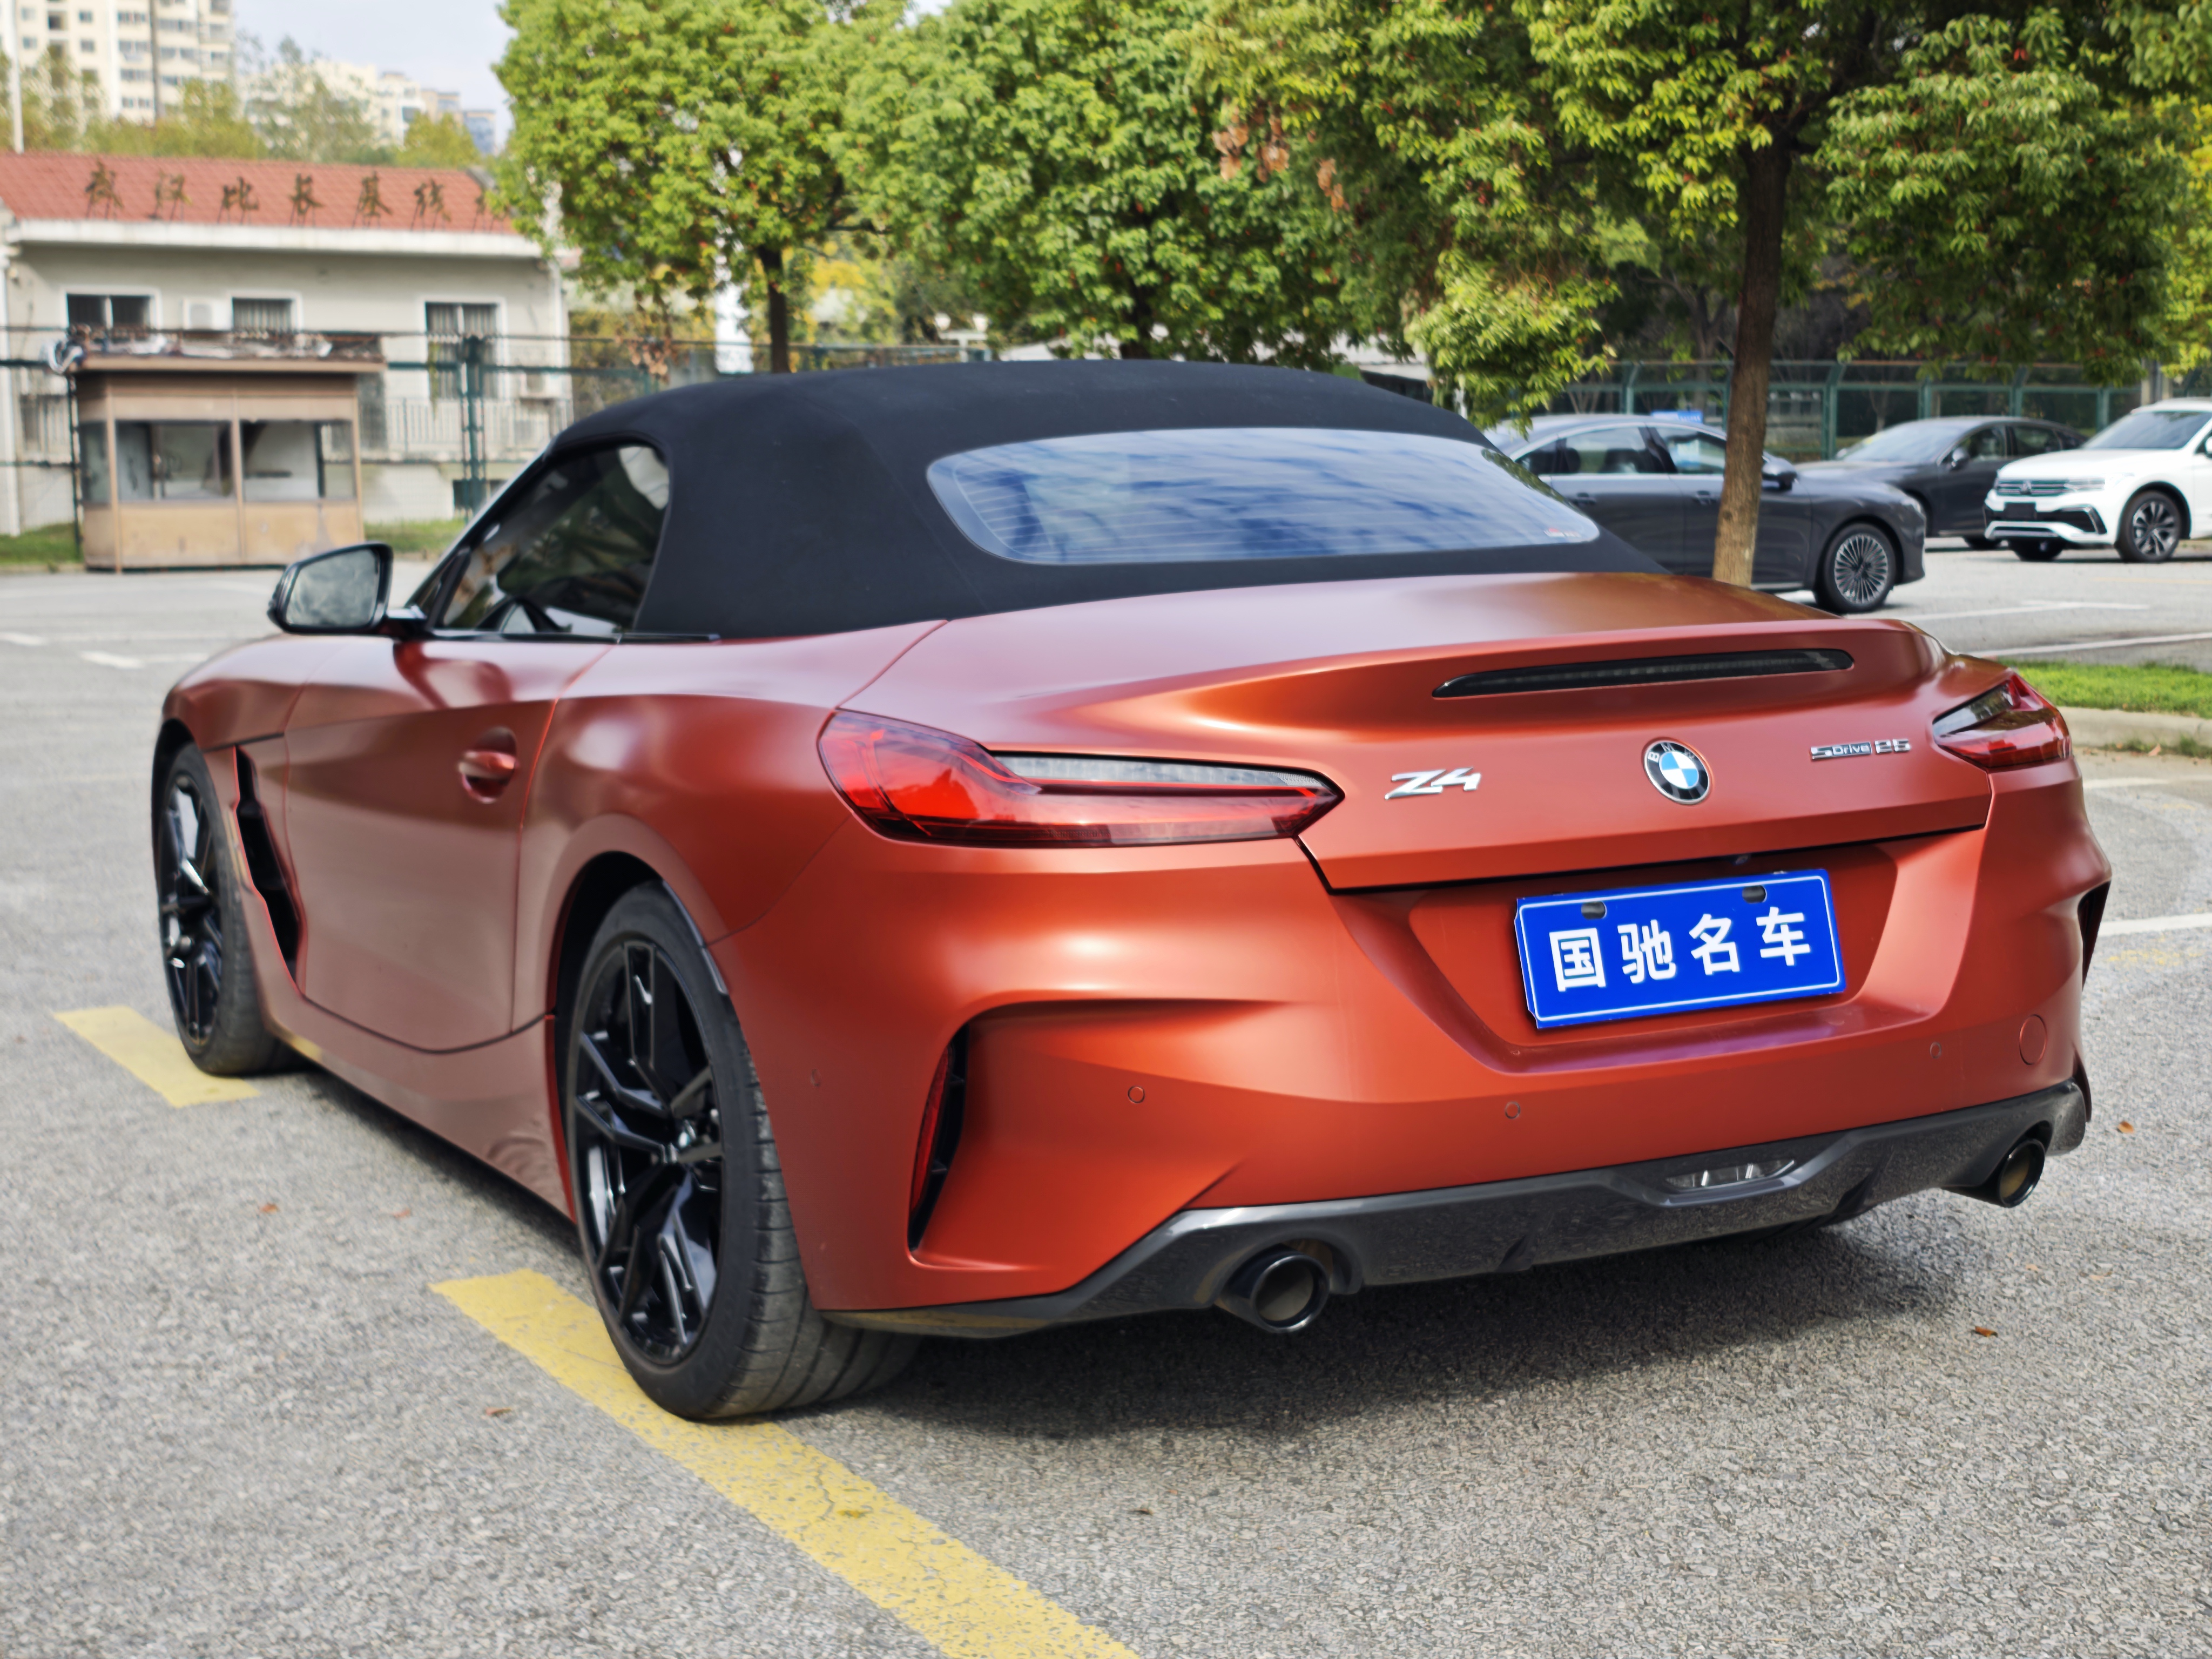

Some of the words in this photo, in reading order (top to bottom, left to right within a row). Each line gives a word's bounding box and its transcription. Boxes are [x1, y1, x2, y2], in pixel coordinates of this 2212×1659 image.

[1648, 742, 1695, 763] BMW
[1384, 767, 1481, 800] Z4
[1549, 906, 1811, 992] 国驰名车
